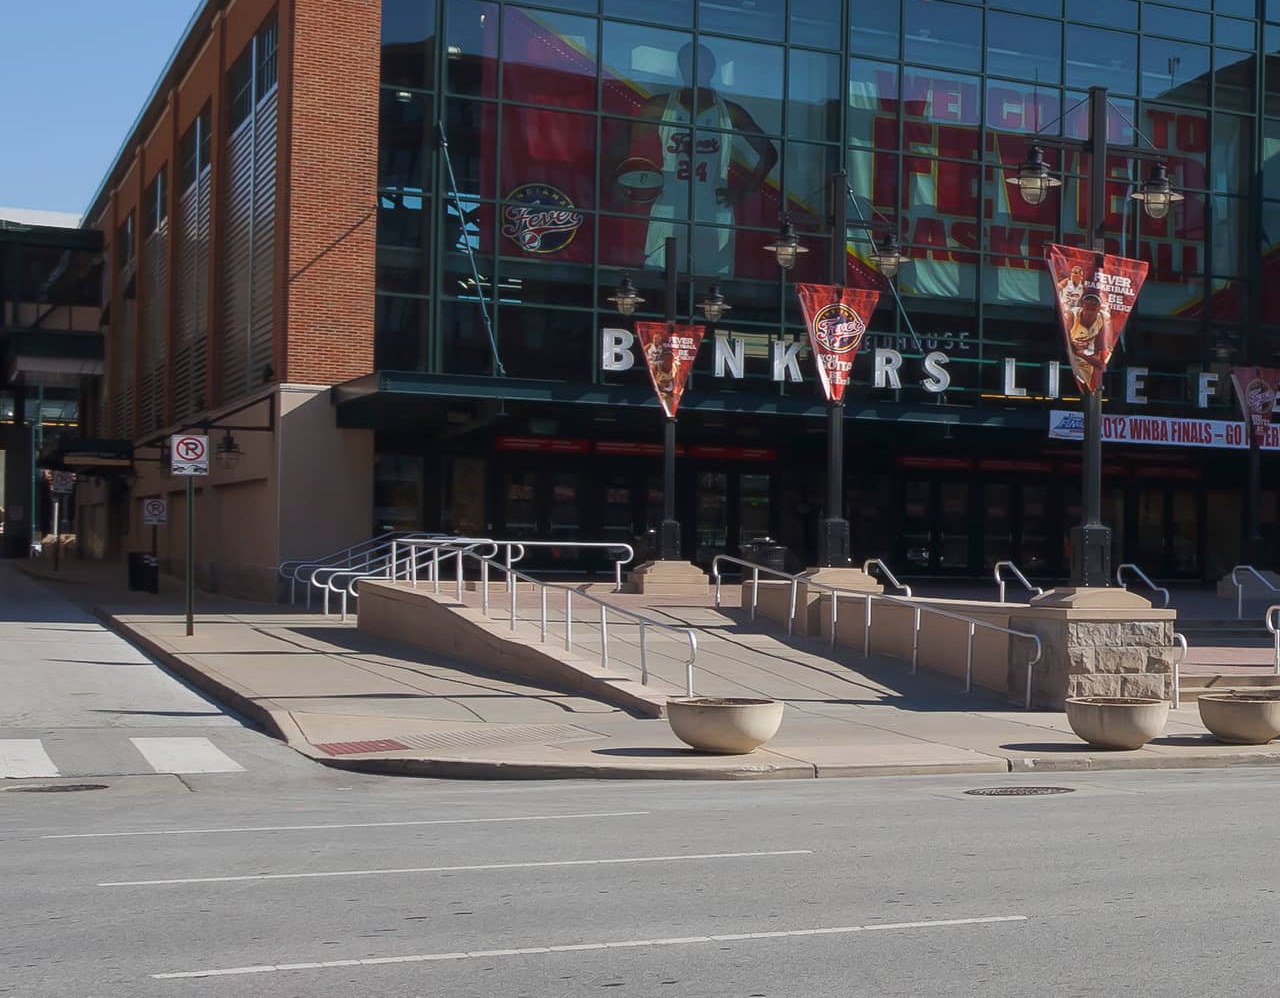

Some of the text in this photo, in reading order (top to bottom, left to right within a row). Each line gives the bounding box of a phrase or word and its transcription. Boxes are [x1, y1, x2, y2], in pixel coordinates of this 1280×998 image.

[675, 160, 707, 182] 24
[500, 206, 584, 239] Fever
[1093, 272, 1131, 288] FEVER
[1107, 293, 1125, 305] BE
[600, 327, 949, 393] BNKRS
[1002, 357, 1149, 405] LIE
[1101, 417, 1127, 440] 012
[1129, 418, 1168, 443] WNBA
[1170, 421, 1213, 444] FINALS
[1225, 424, 1242, 446] GO
